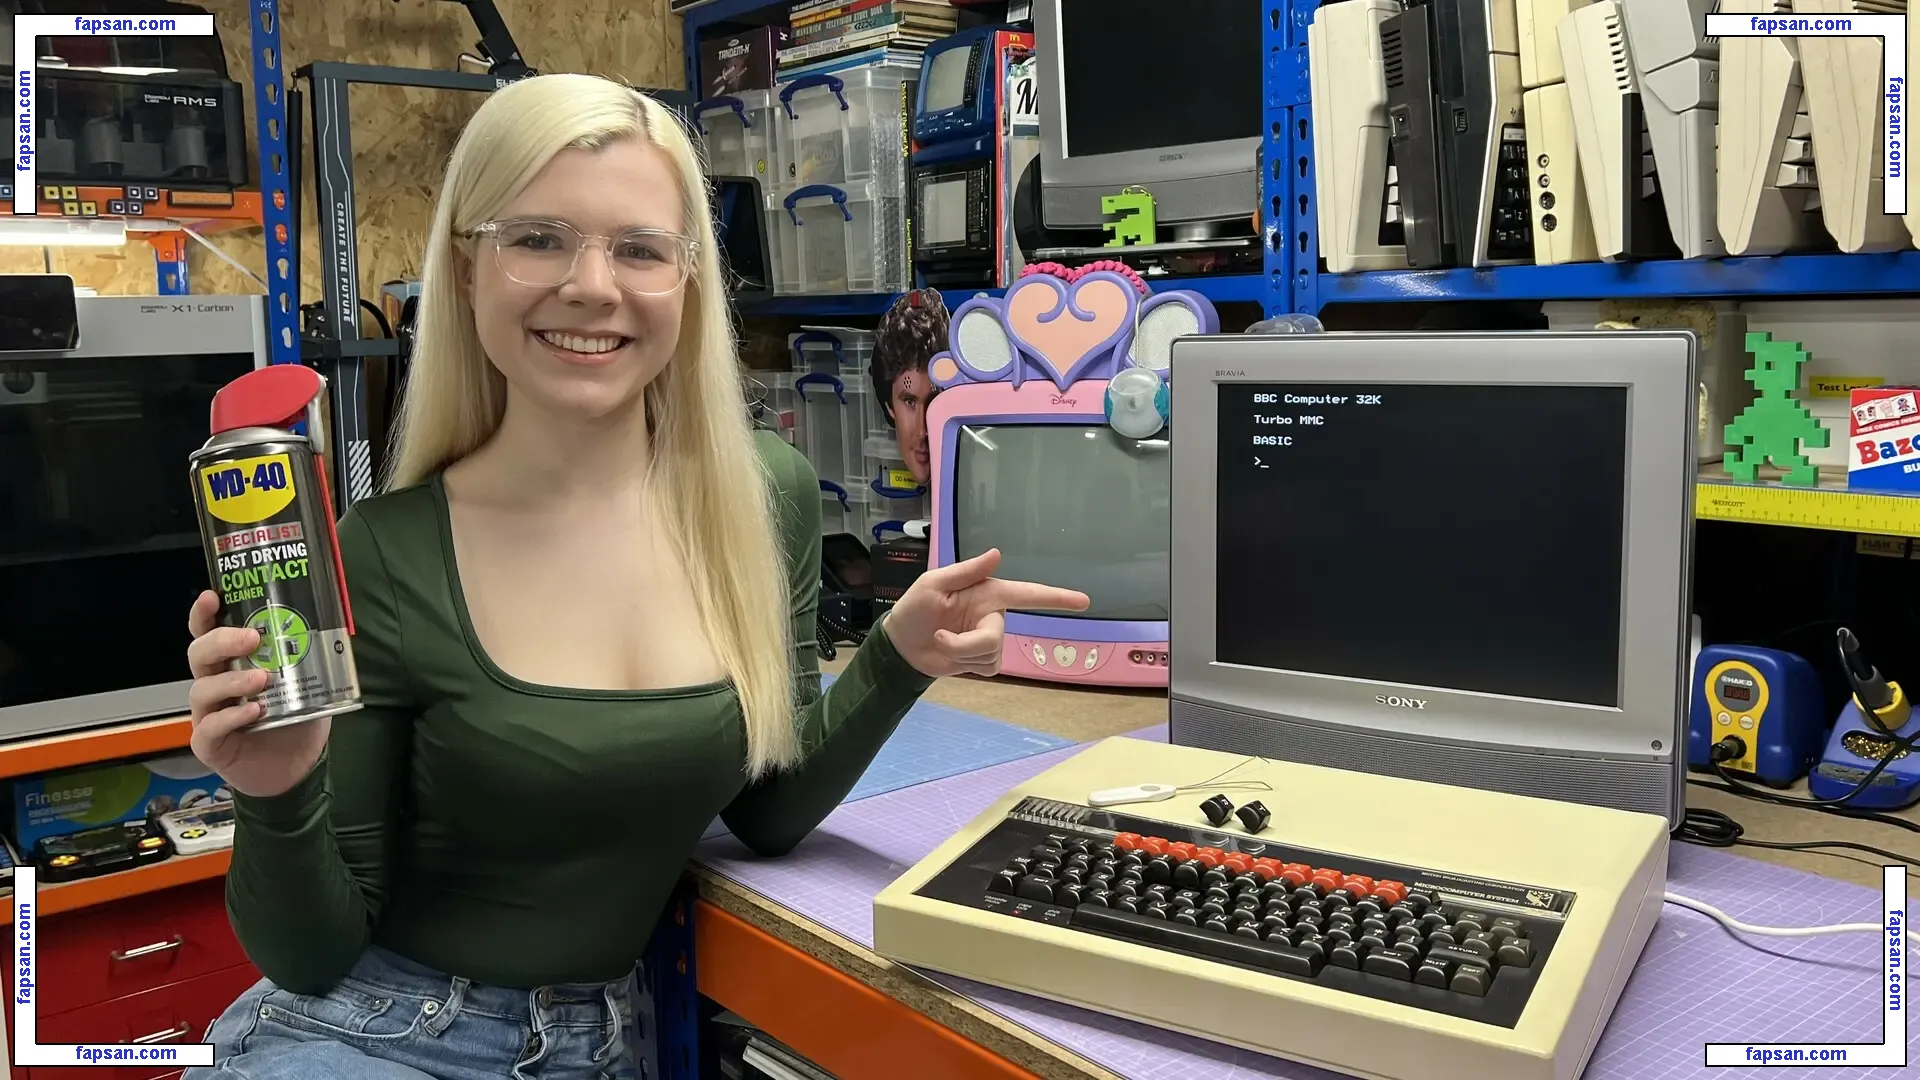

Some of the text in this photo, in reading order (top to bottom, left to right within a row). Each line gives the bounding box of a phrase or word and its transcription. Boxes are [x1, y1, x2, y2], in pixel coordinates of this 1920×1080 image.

[173, 96, 217, 107] AMS
[336, 202, 351, 322] CREATE THE FUTURE
[1817, 383, 1841, 392] Test
[1253, 393, 1382, 406] BBC Computer 32K
[1253, 414, 1325, 425] Turbo MMC
[1253, 435, 1293, 446] BASIC
[207, 461, 287, 502] WD-40
[1712, 499, 1746, 508] WESTCOTT
[216, 525, 300, 552] SPECIALIST
[217, 542, 308, 573] FAST DRYING
[221, 558, 308, 592] CONTACT
[224, 586, 265, 605] CLEANER
[1375, 694, 1428, 710] SONY
[25, 786, 93, 807] Finesse
[1414, 882, 1485, 899] MICROCOMPUTER
[1486, 894, 1520, 904] SYSTEM
[1485, 882, 1526, 892] CORPORATION
[1448, 945, 1479, 955] RETURN
